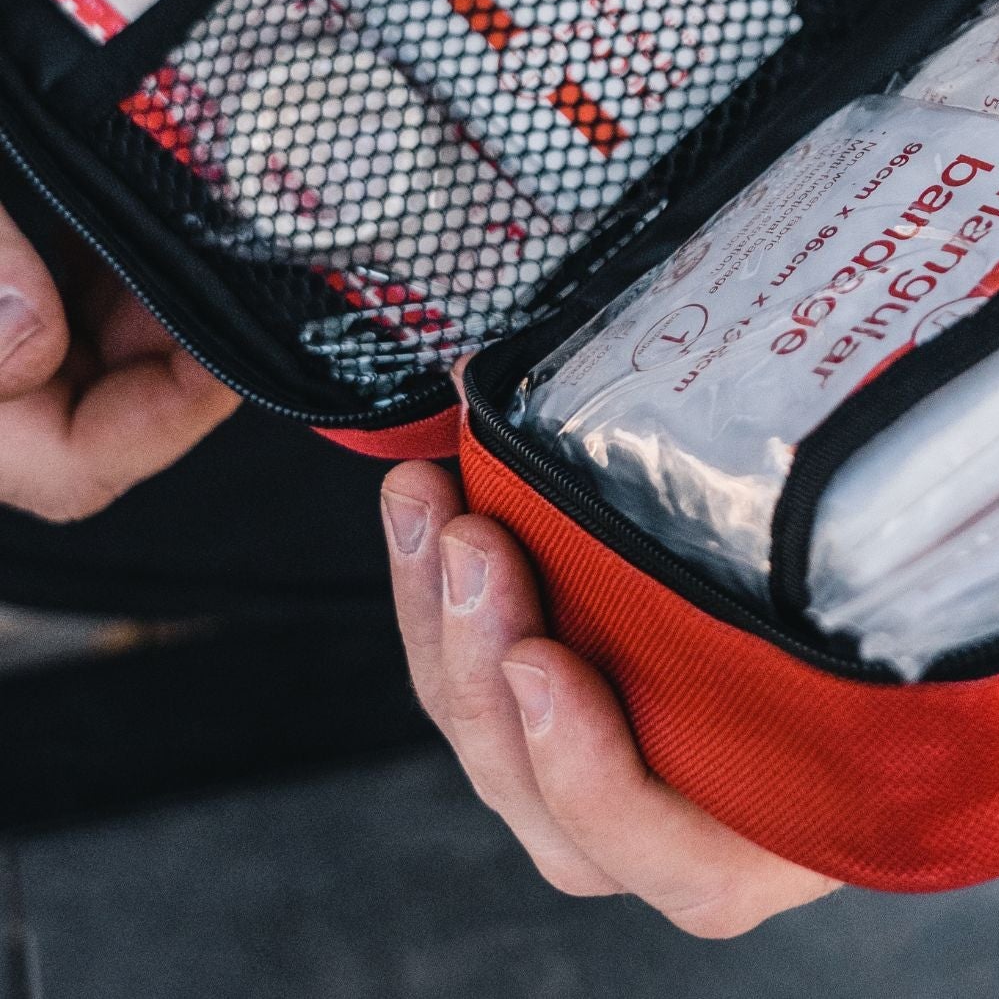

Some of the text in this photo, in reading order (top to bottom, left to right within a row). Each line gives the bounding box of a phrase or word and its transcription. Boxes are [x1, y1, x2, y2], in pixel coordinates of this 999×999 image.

[799, 141, 876, 213] Non-woven
[853, 141, 922, 200] 96cm
[708, 138, 863, 295] Multi-functional bandage
[769, 224, 838, 288] 96cm
[770, 154, 995, 356] bandage
